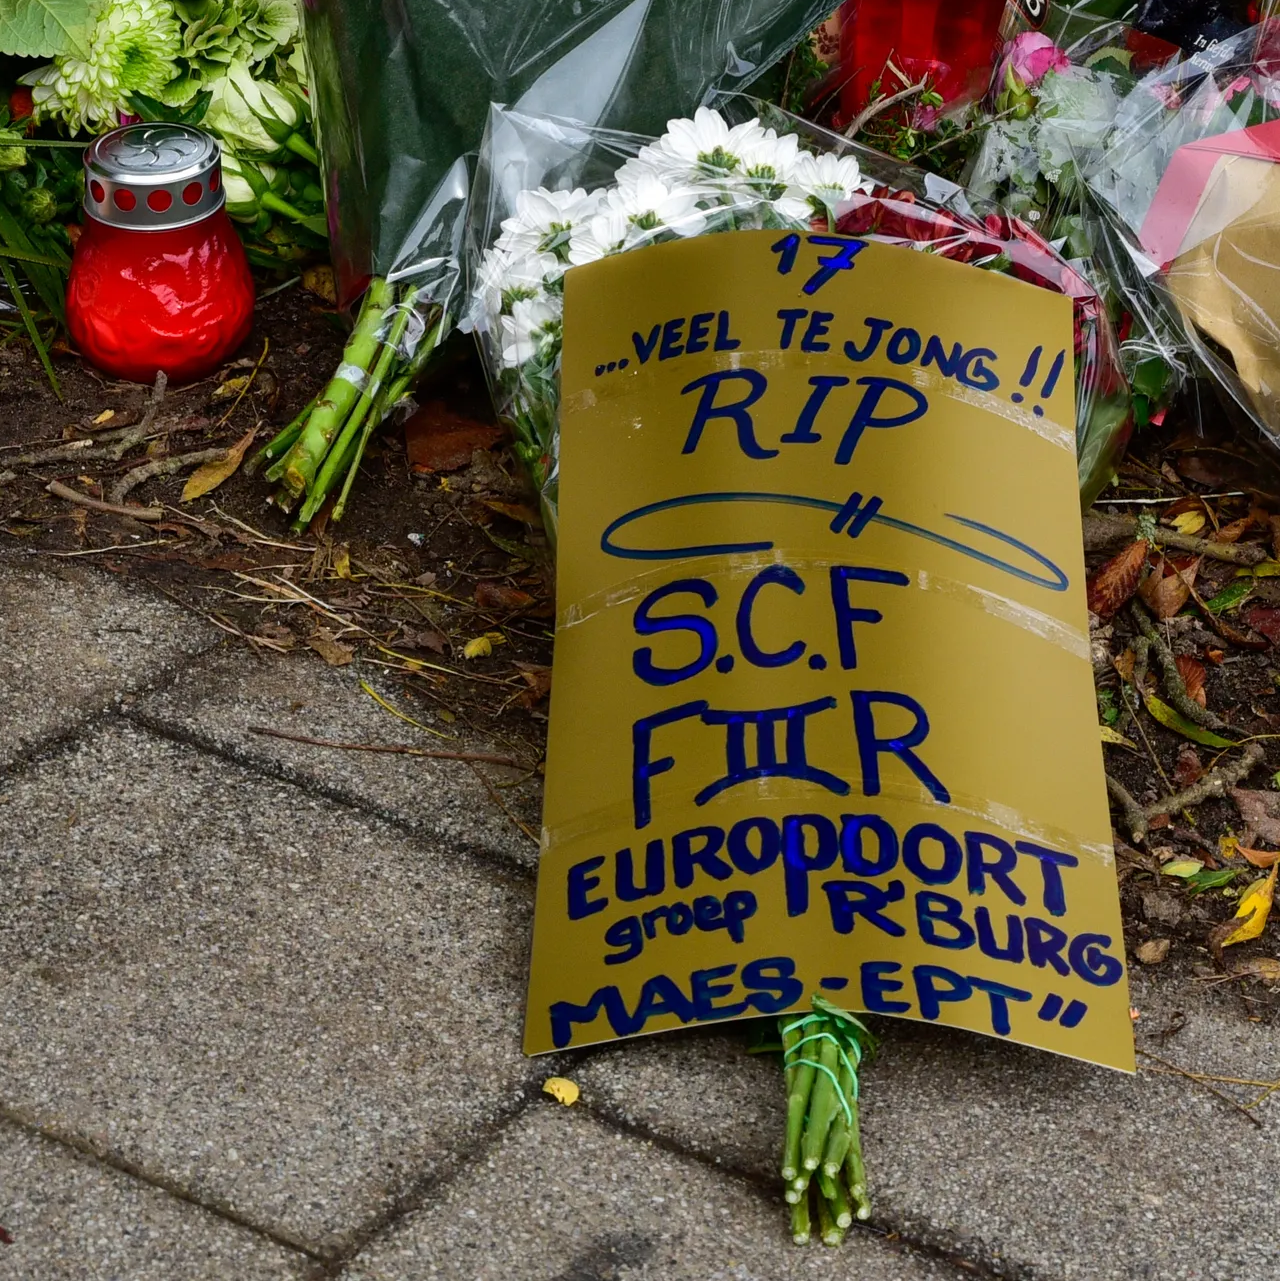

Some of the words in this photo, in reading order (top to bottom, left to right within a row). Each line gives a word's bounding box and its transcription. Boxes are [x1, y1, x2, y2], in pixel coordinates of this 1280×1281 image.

[769, 234, 869, 295] 17
[776, 307, 833, 354] TE
[679, 366, 928, 466] RIP
[602, 889, 758, 966] groep
